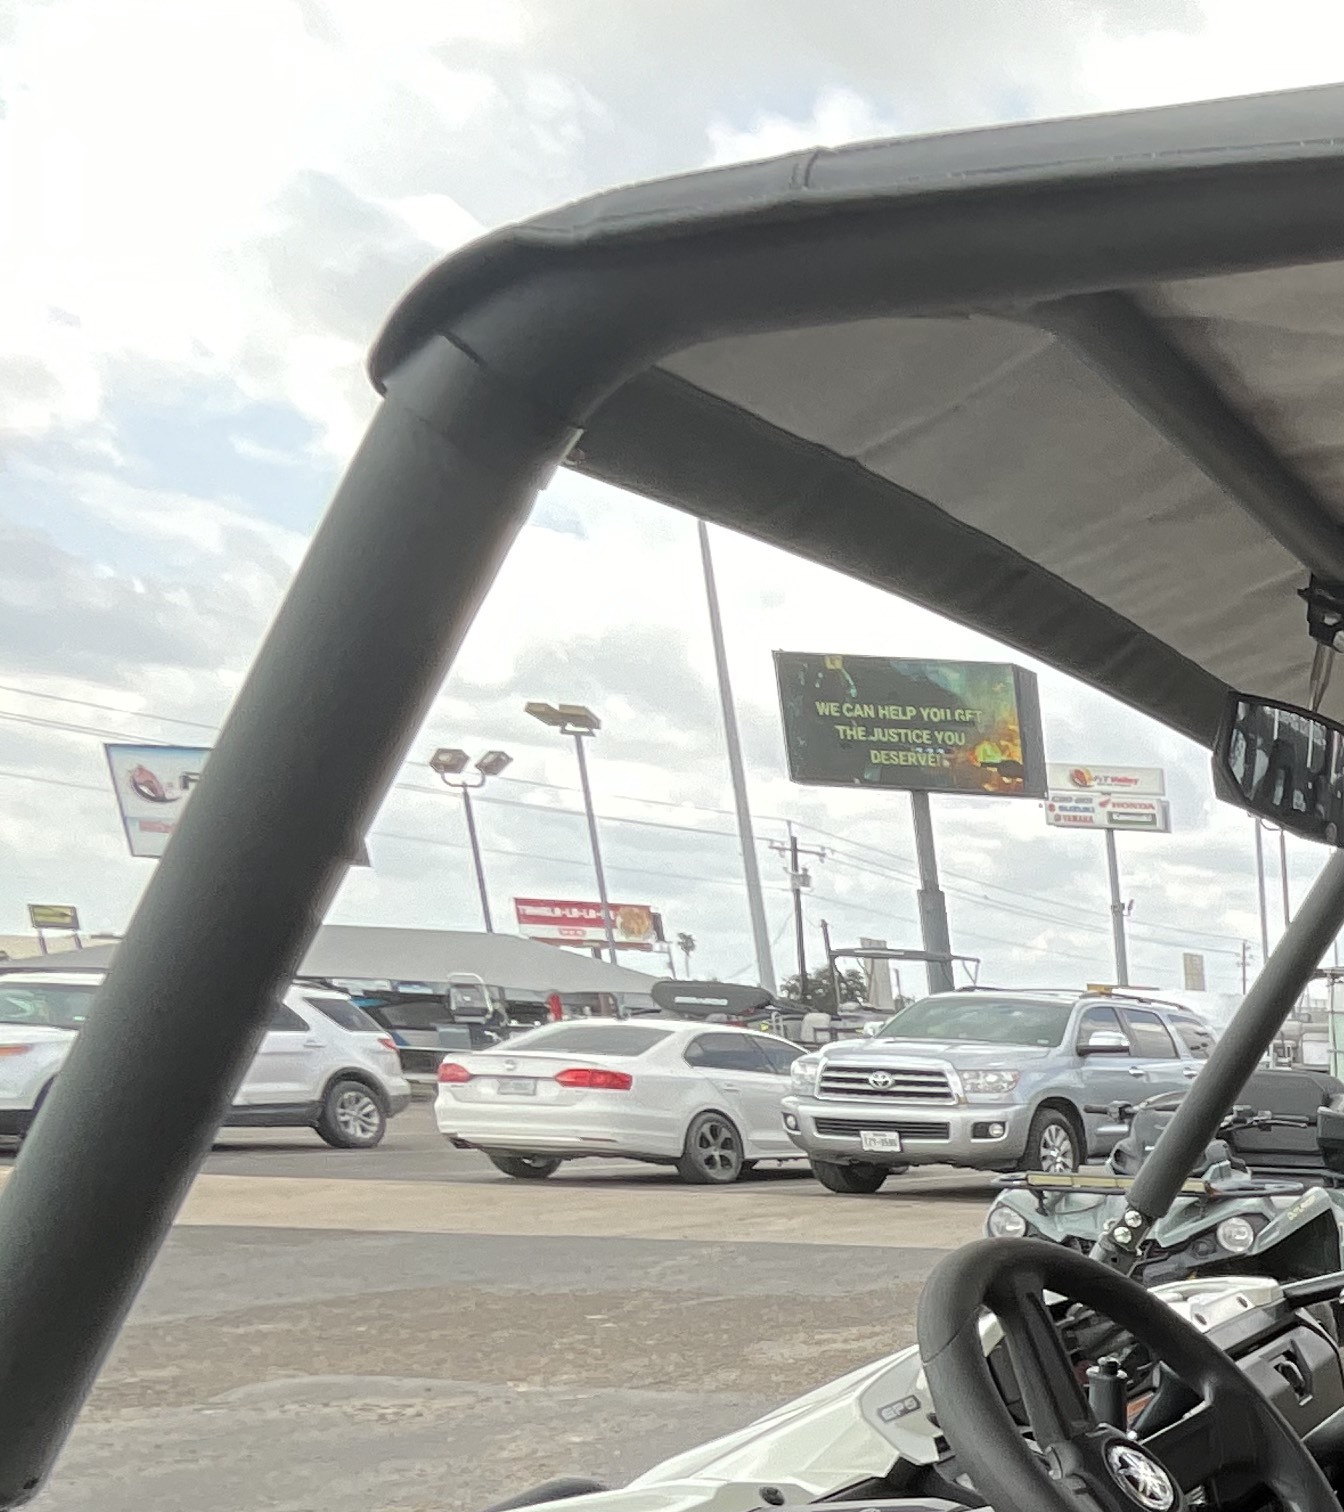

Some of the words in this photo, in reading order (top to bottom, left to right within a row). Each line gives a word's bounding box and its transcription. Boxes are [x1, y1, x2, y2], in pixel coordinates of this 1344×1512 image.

[815, 702, 840, 716] WE
[842, 703, 874, 718] CAN
[879, 706, 916, 720] HELP
[921, 708, 951, 722] YOU
[835, 725, 866, 740] THE
[869, 727, 931, 744] JUSTICE
[934, 731, 965, 745] YOU
[1112, 801, 1155, 810] HONDA
